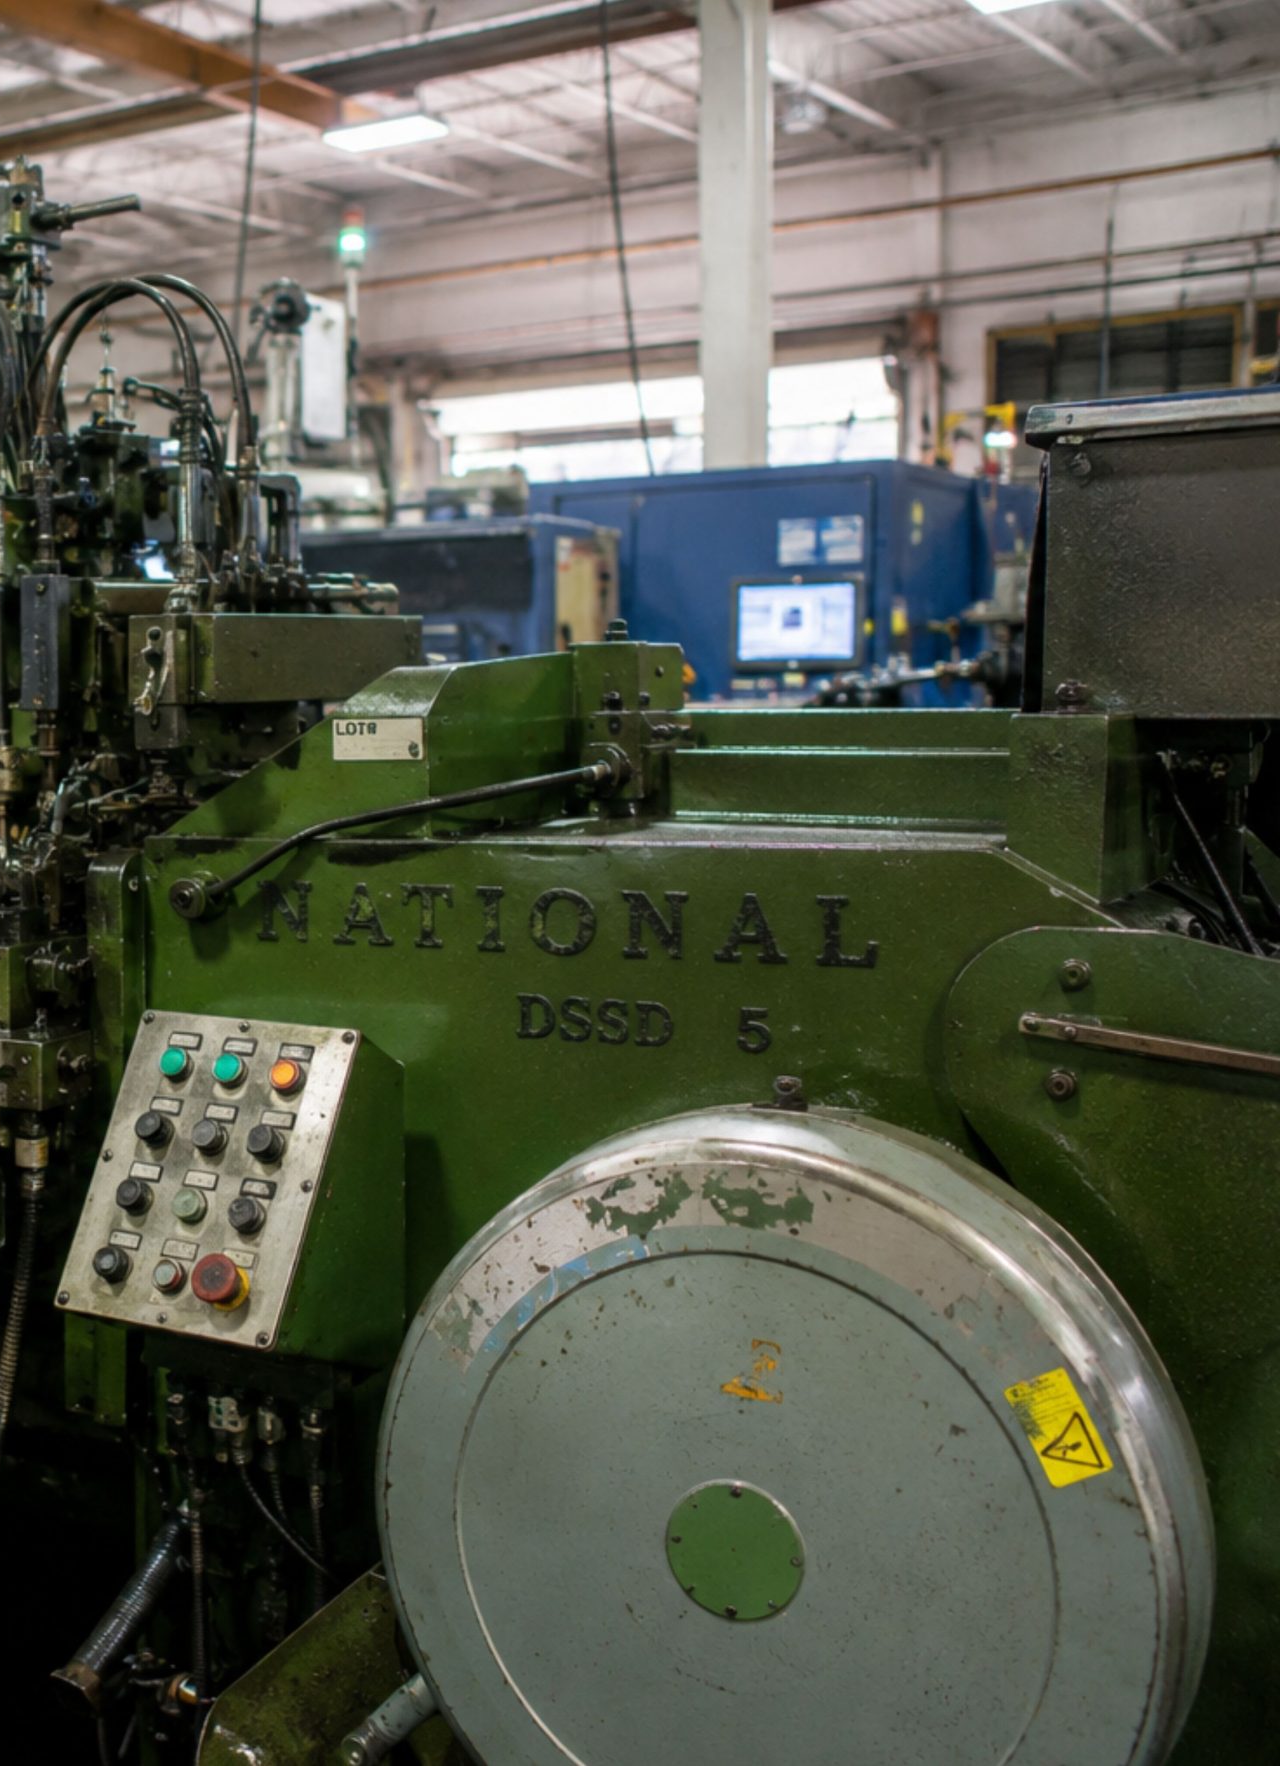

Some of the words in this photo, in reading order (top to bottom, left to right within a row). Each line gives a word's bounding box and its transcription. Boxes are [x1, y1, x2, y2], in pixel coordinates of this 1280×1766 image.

[257, 880, 880, 968] NATIONAL
[516, 993, 674, 1046] DSSD
[736, 1006, 772, 1053] 5
